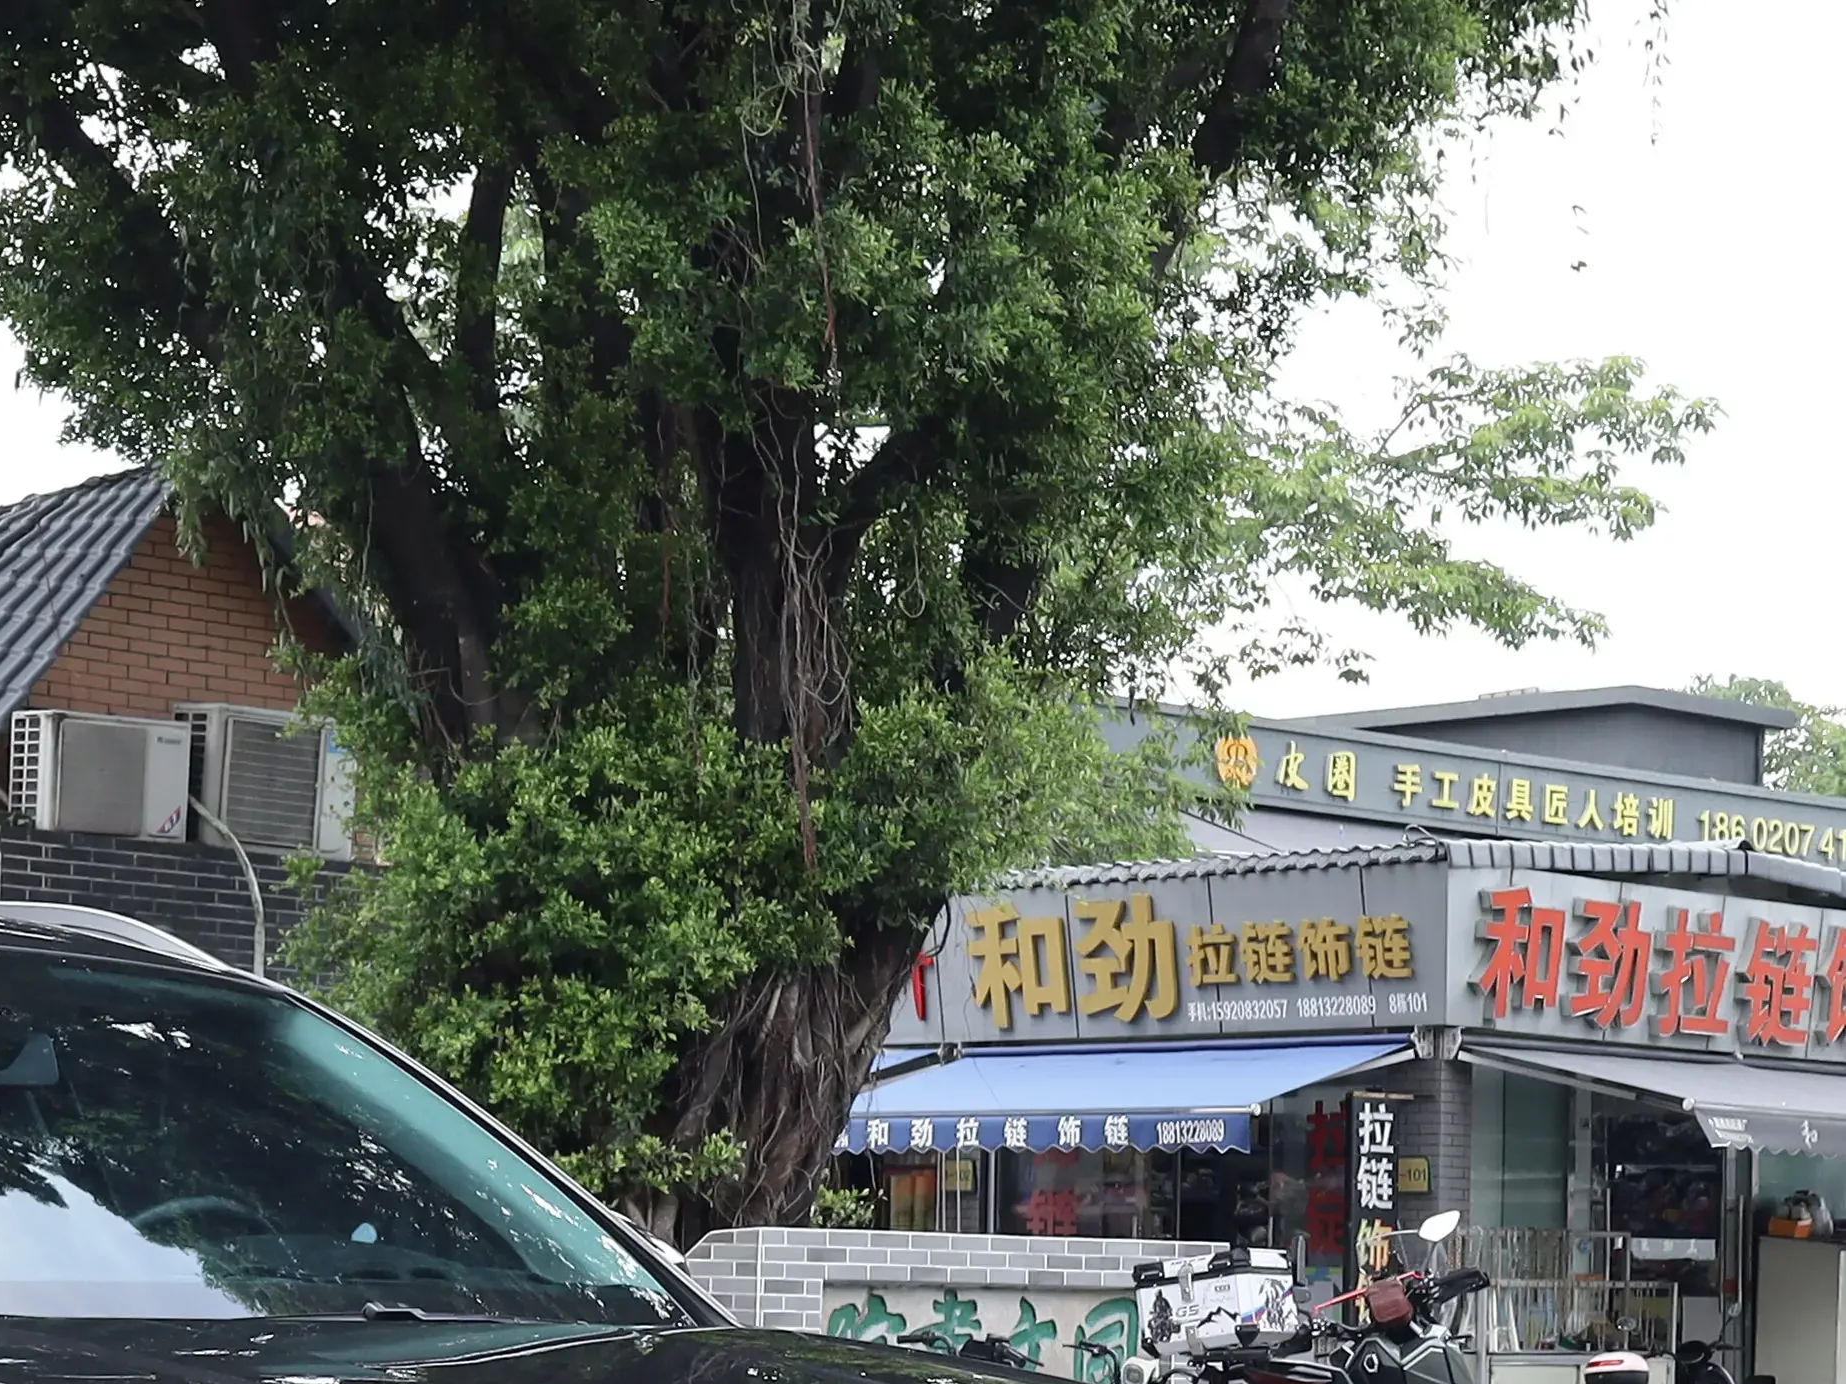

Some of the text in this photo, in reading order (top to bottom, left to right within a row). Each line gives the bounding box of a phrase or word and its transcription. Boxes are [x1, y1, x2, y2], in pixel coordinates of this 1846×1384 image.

[1393, 764, 1674, 841] 手工皮具匠人培训
[1752, 817, 1815, 857] 0207
[965, 894, 1178, 1029] 和劲
[1186, 914, 1414, 988] 拉链饰链
[1297, 995, 1377, 1017] 18813228089
[1156, 1120, 1226, 1145] 18813228089
[1175, 1304, 1200, 1318] GS
